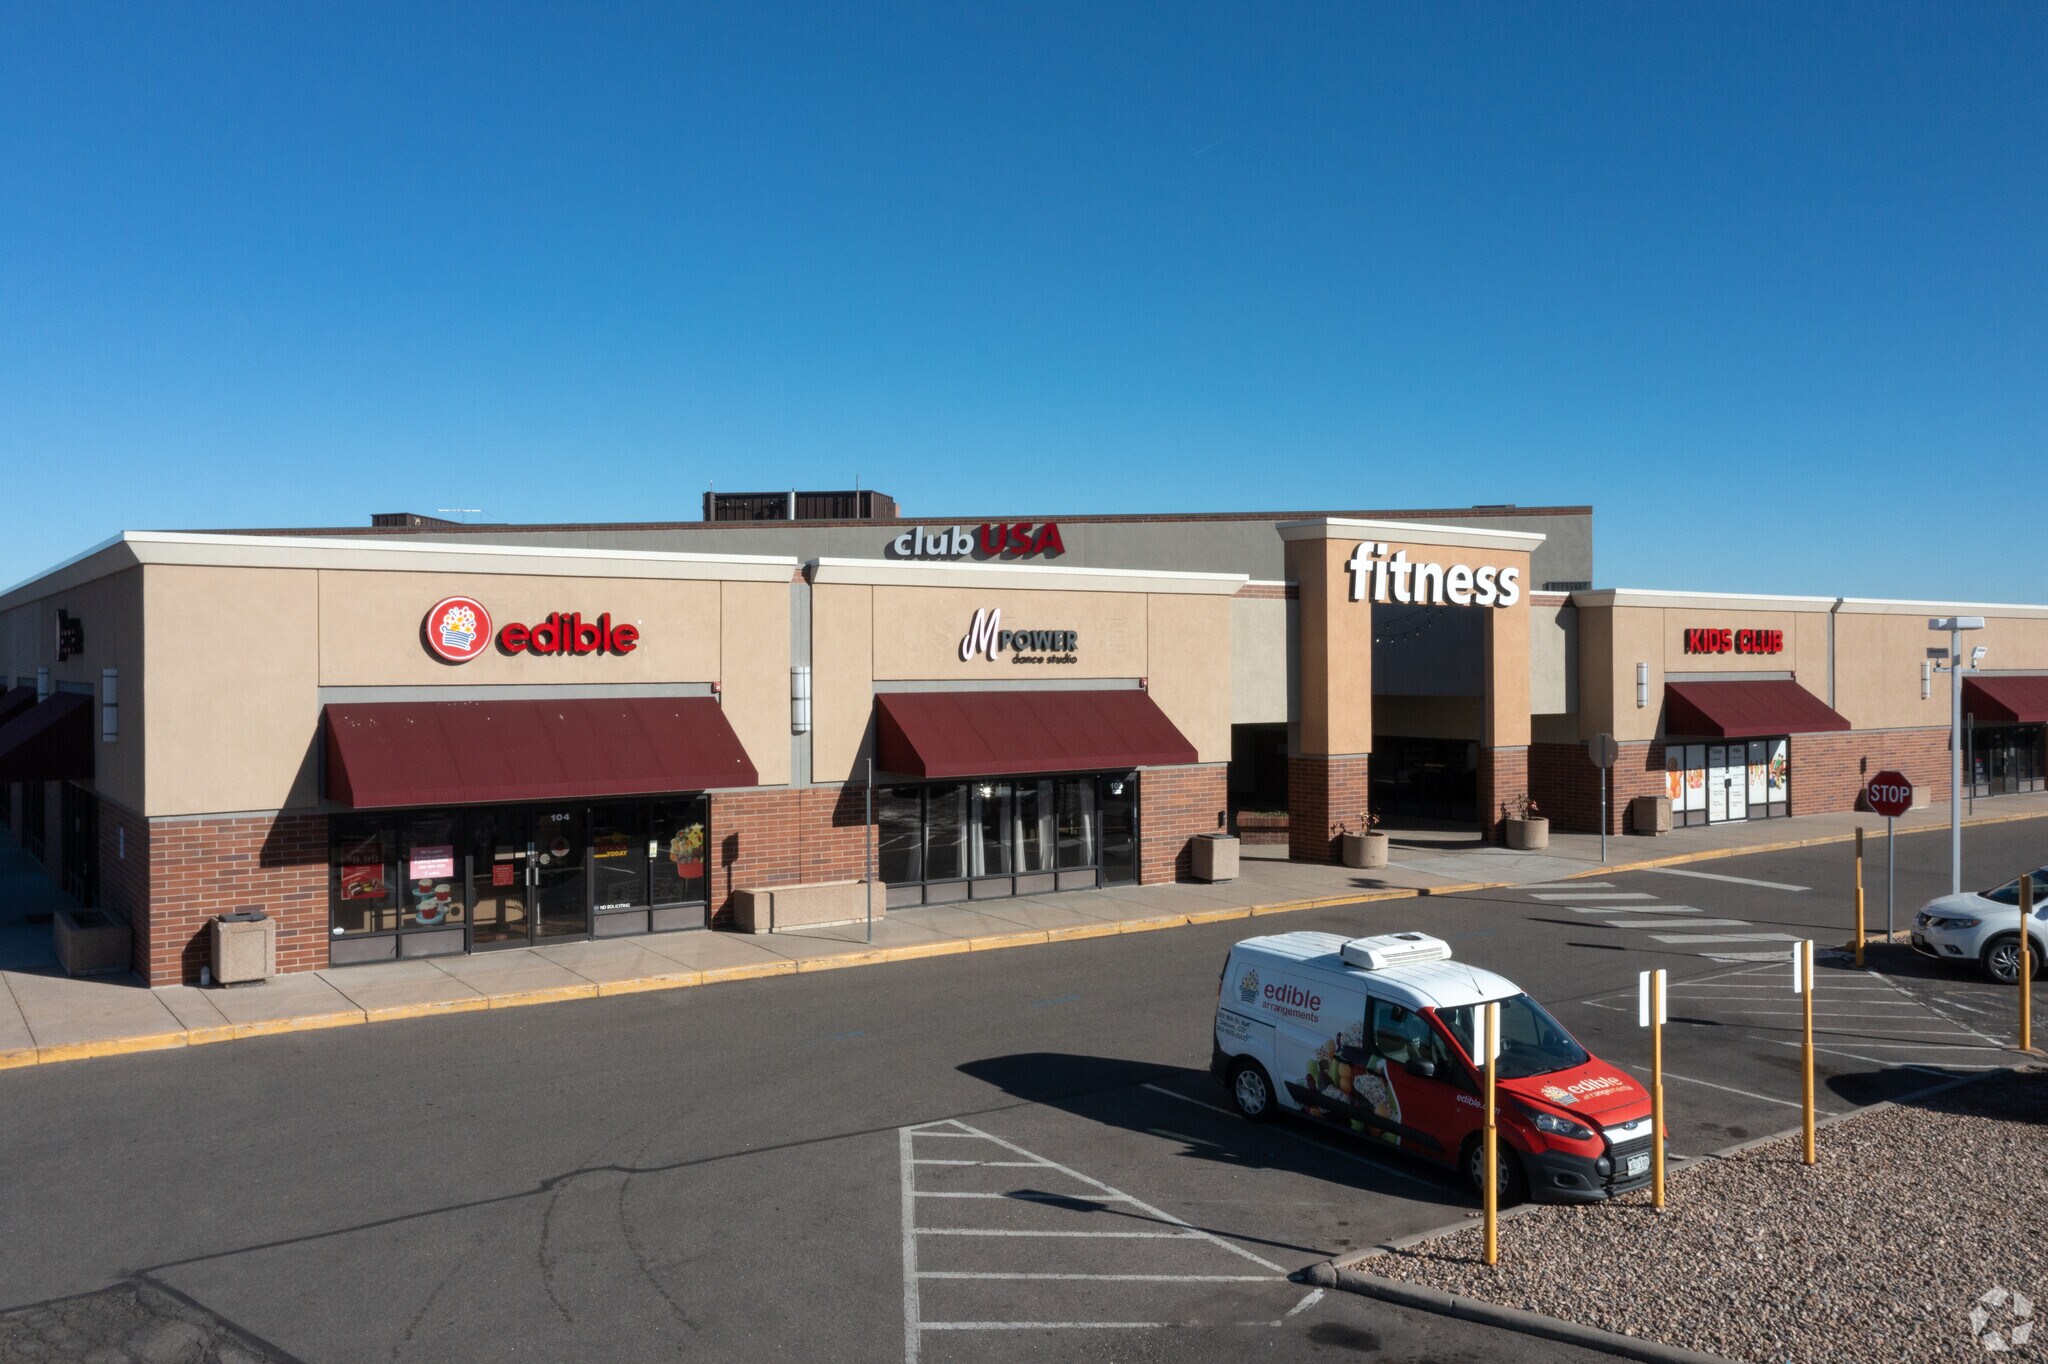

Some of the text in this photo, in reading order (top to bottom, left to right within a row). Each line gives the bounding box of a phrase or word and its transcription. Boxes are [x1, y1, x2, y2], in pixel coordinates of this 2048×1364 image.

[893, 522, 1066, 556] club USA
[1350, 541, 1520, 606] fitness
[501, 611, 640, 653] edible
[1688, 627, 1784, 653] KIDS CLUB
[1011, 652, 1079, 665] dance studio
[1870, 784, 1911, 803] STOP
[550, 812, 571, 822] 104
[607, 902, 631, 910] SOLICITING
[1264, 983, 1321, 1012] edible
[1262, 1001, 1320, 1023] arrangements
[1567, 1076, 1623, 1094] edible
[1583, 1085, 1634, 1101] arrangements
[1456, 1094, 1501, 1115] edible.cm
